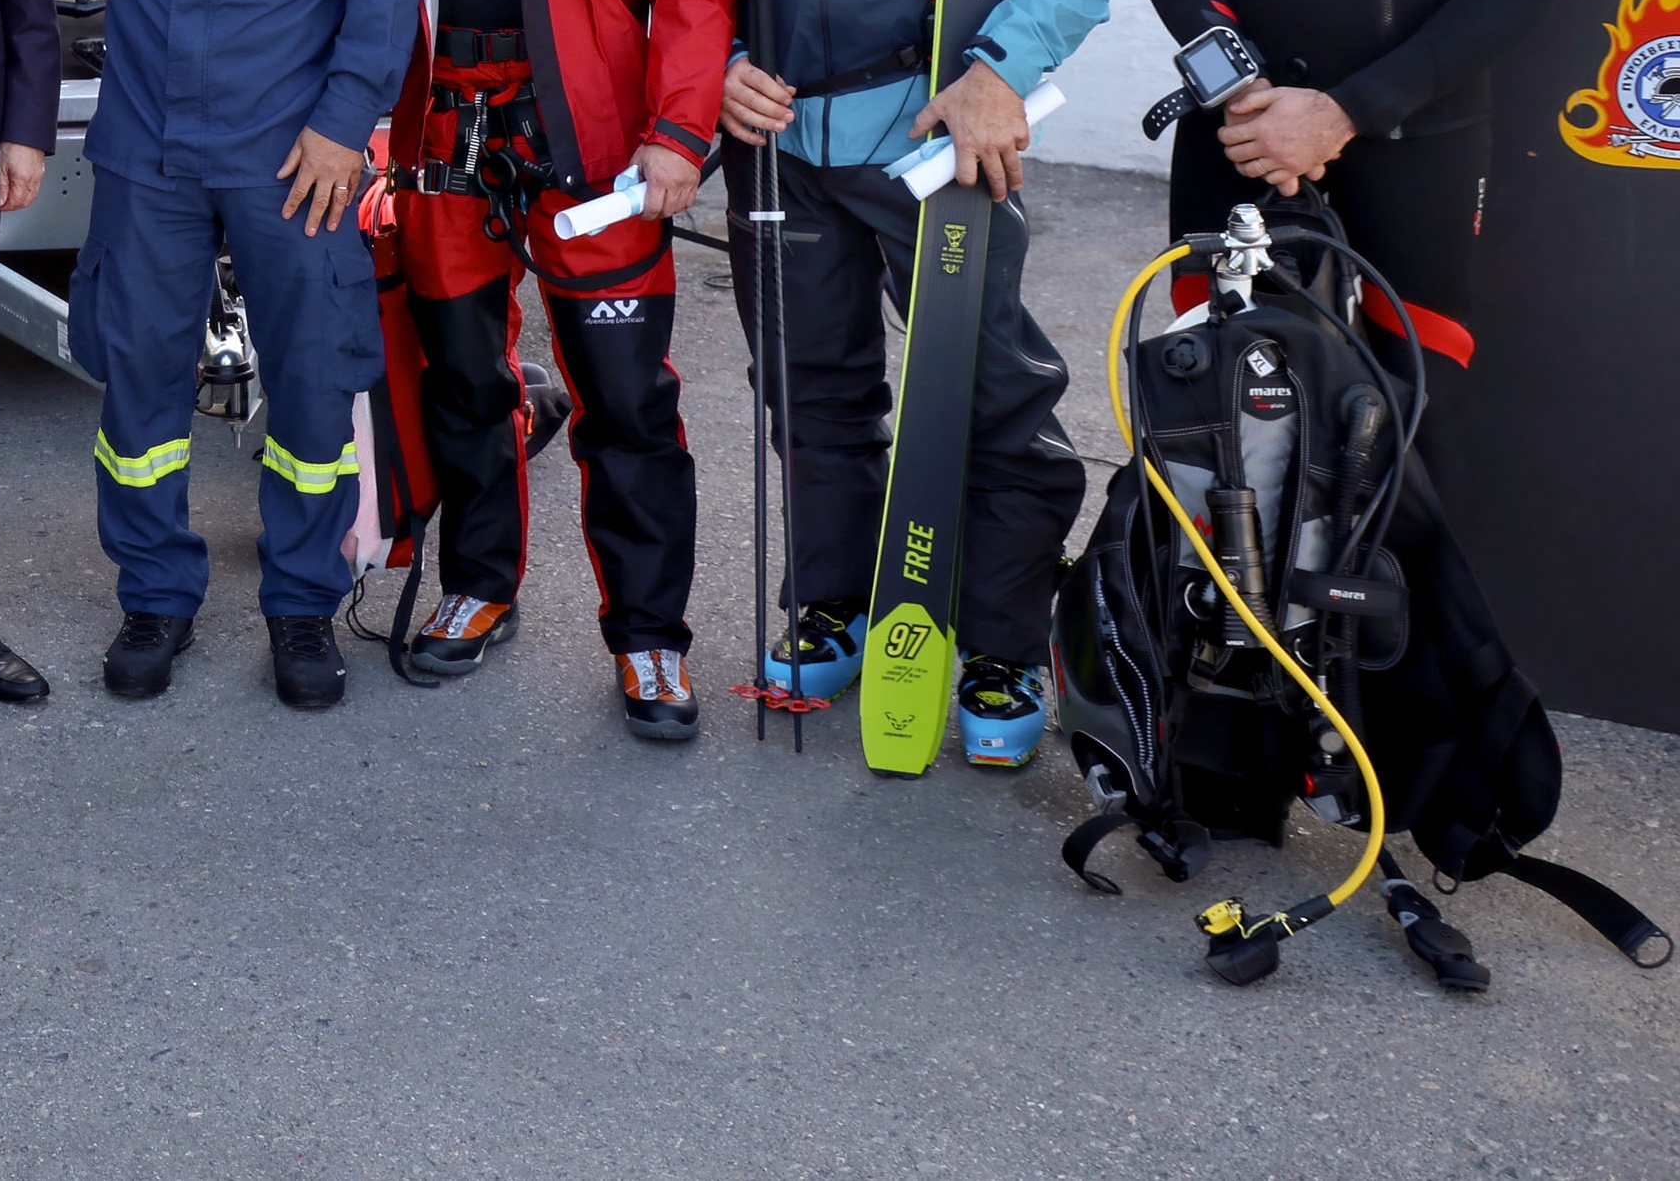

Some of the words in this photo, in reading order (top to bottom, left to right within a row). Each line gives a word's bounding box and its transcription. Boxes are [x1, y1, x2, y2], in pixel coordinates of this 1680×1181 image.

[1251, 354, 1266, 373] XL
[1248, 387, 1292, 397] mares
[903, 520, 935, 585] FREE
[884, 621, 932, 660] 97
